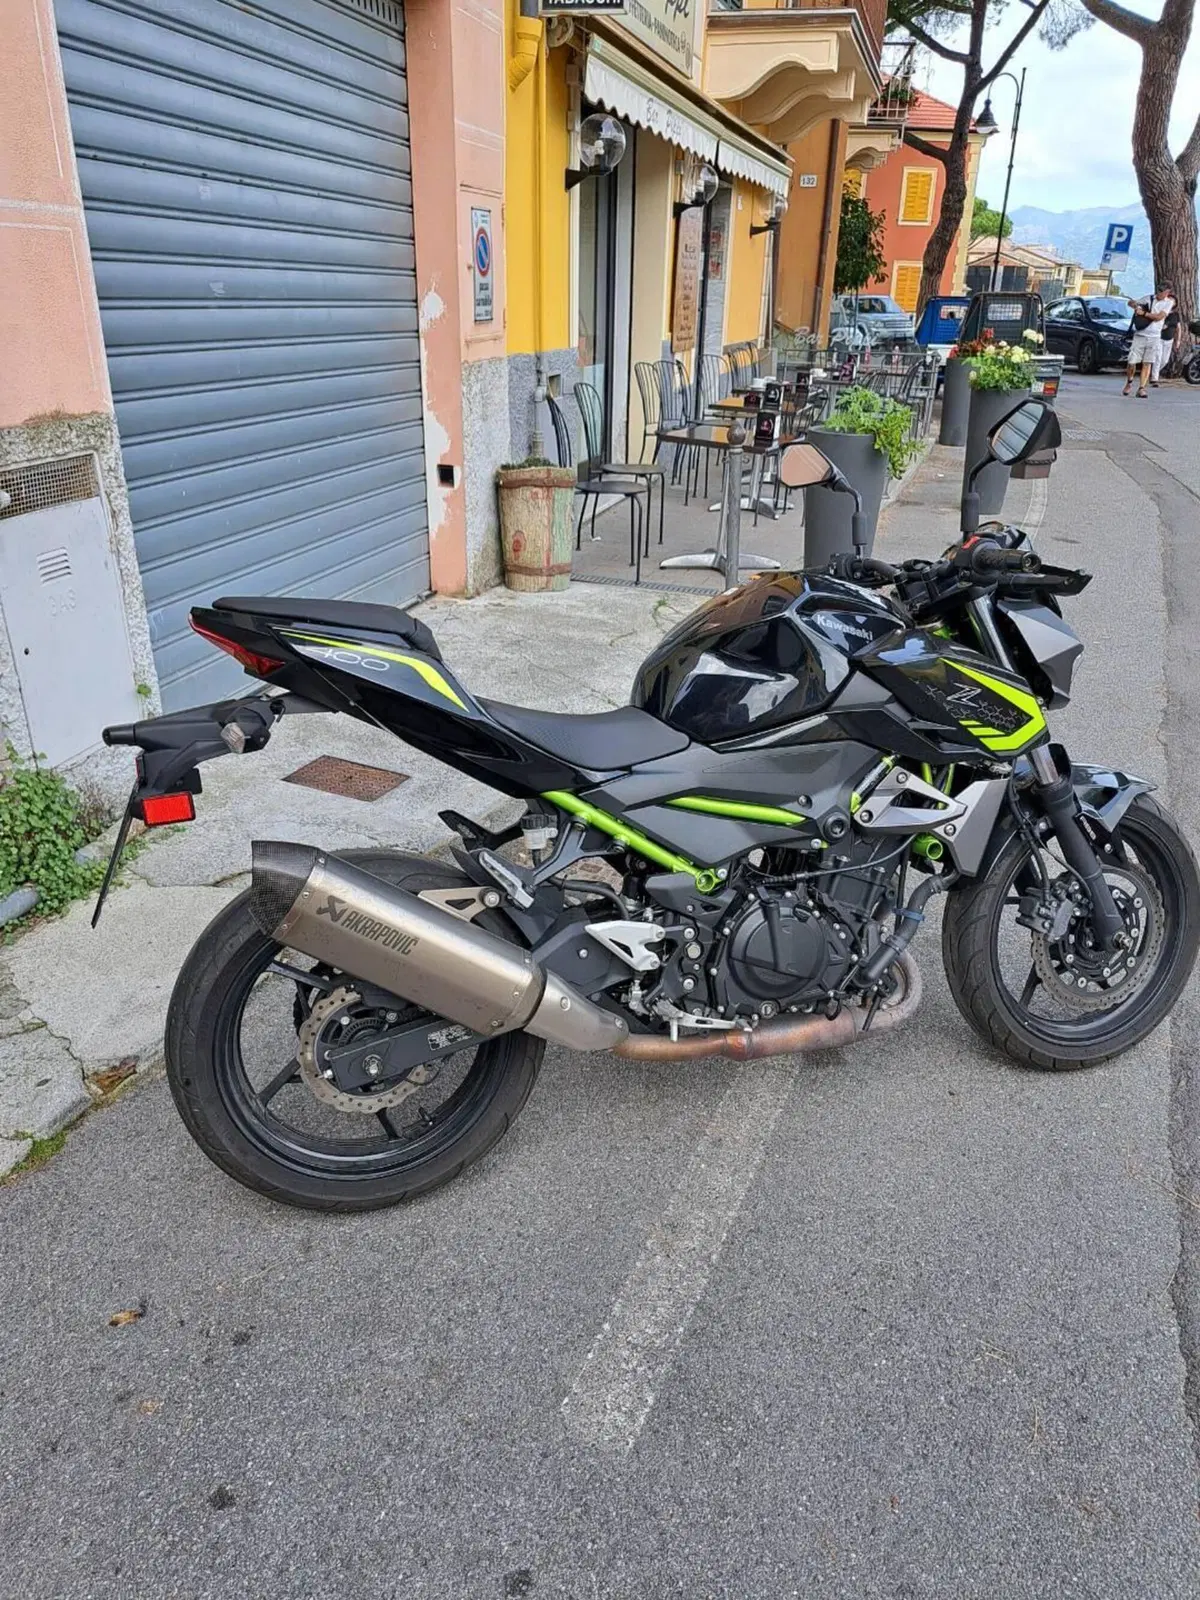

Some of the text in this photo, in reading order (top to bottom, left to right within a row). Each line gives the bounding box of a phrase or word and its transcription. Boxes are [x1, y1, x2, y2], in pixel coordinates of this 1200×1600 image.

[1110, 226, 1128, 249] P
[817, 614, 874, 642] Kawasaki
[305, 647, 390, 672] 400
